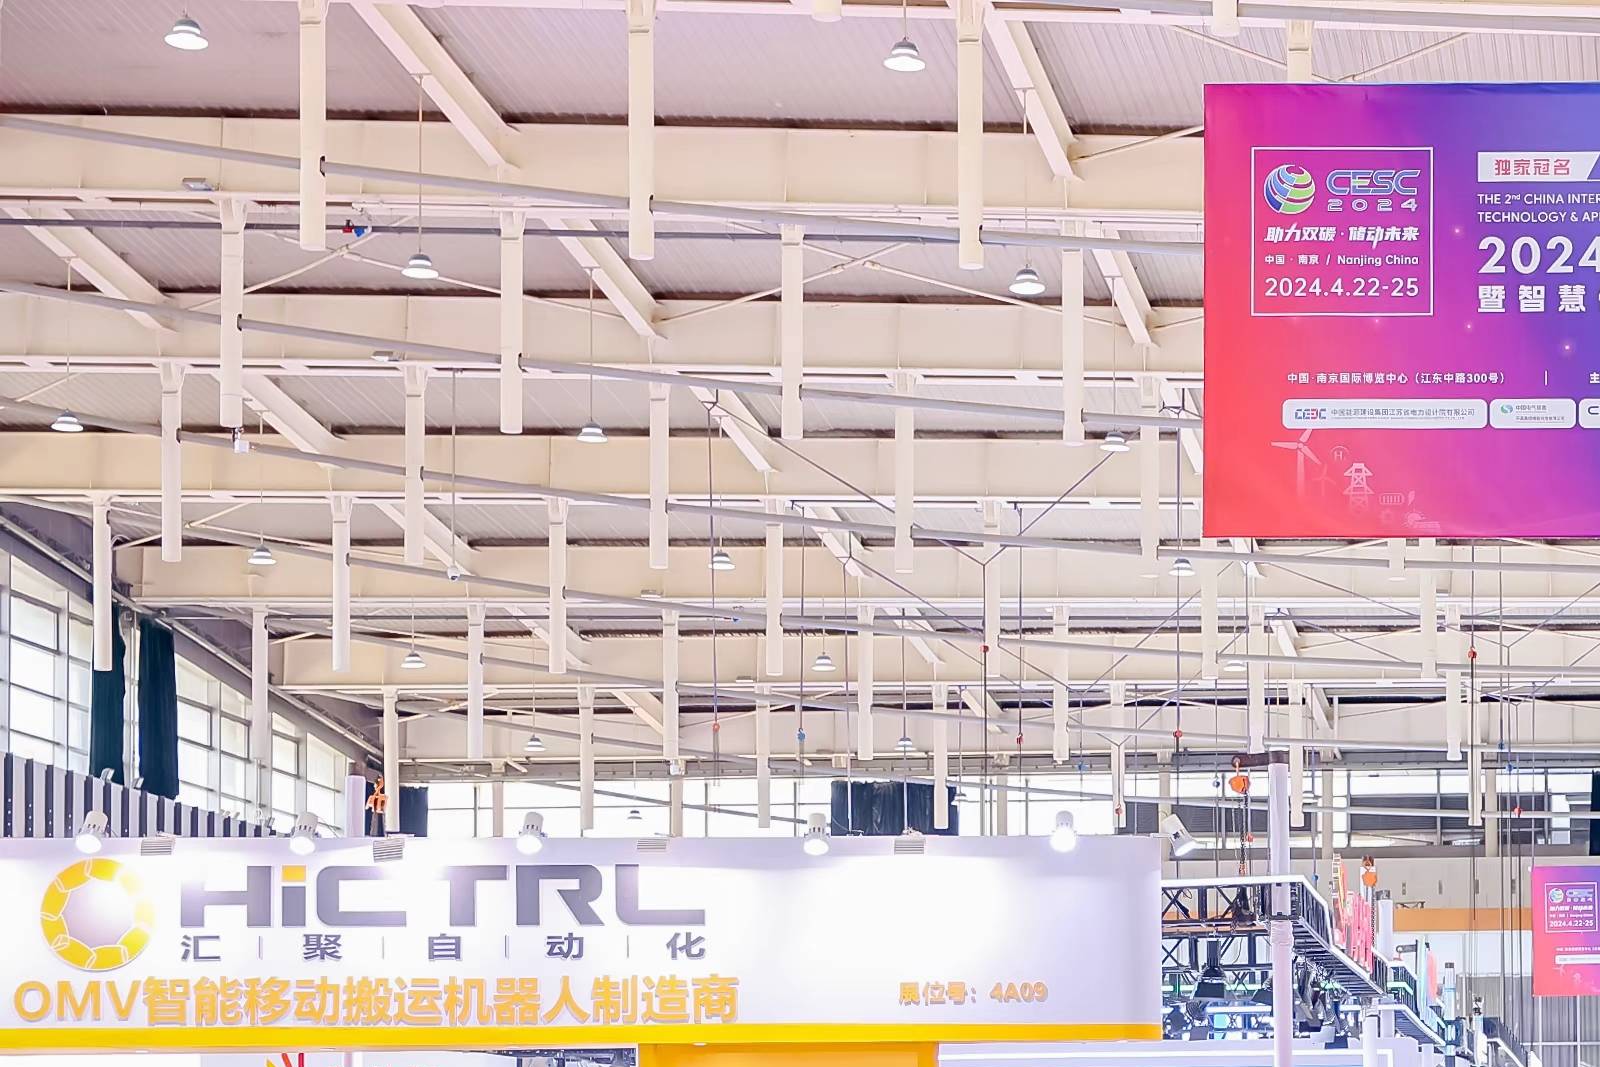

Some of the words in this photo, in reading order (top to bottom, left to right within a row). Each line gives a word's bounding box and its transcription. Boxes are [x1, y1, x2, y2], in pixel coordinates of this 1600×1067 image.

[1494, 159, 1571, 177] 独家冠名
[1326, 169, 1422, 195] CESC
[1327, 199, 1418, 213] 2024
[1477, 193, 1501, 205] THE
[1504, 193, 1521, 205] 2nd
[1524, 194, 1564, 205] CHINA
[1477, 211, 1567, 223] TECHNOLOGY
[1569, 211, 1579, 223] &
[1337, 254, 1382, 267] Nanjing
[1385, 254, 1419, 266] China
[1264, 277, 1420, 298] 2024.4.22-25
[13, 975, 740, 1027] OMV智能移动搬运机器人制造商
